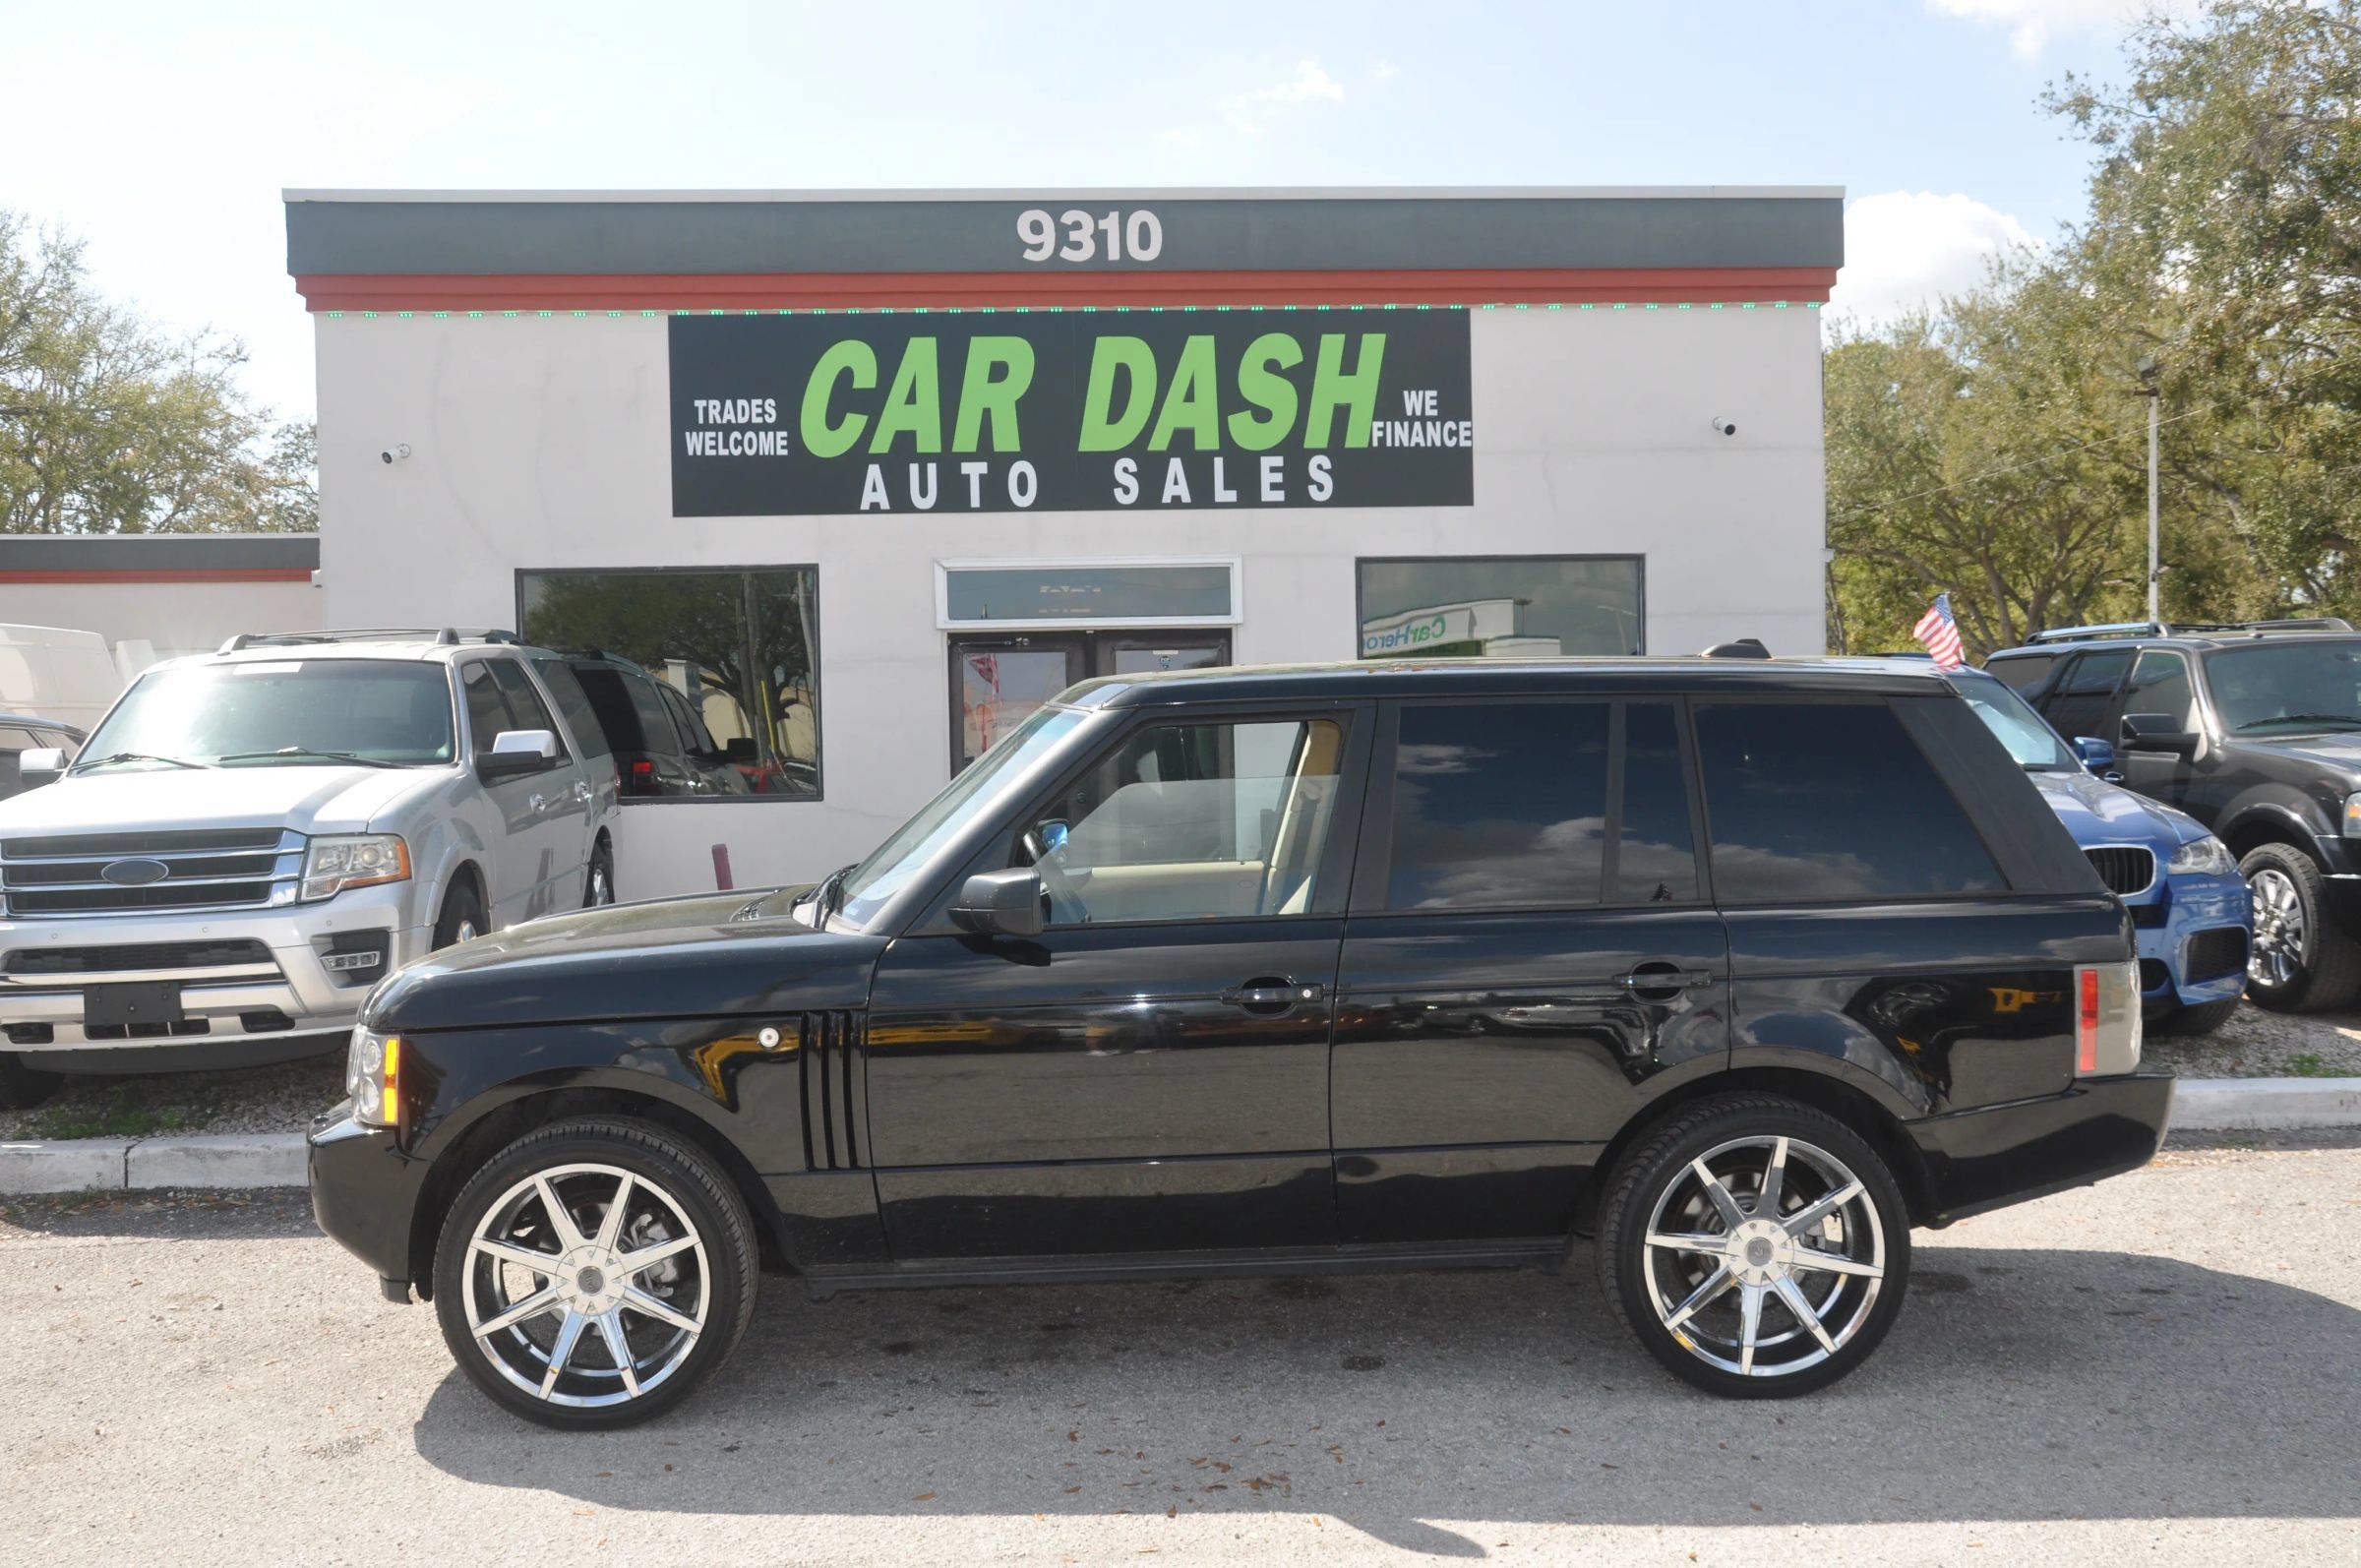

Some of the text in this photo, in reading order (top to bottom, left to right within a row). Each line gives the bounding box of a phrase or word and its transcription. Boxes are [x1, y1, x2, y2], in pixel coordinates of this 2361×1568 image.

[1016, 209, 1163, 263] 9310
[800, 332, 1387, 458] CAR DASH
[1403, 390, 1439, 417] WE
[694, 398, 777, 425] TRADES
[685, 431, 789, 456] WELCOME
[1371, 420, 1473, 448] FINANCE
[860, 454, 1334, 511] AUTO SALES
